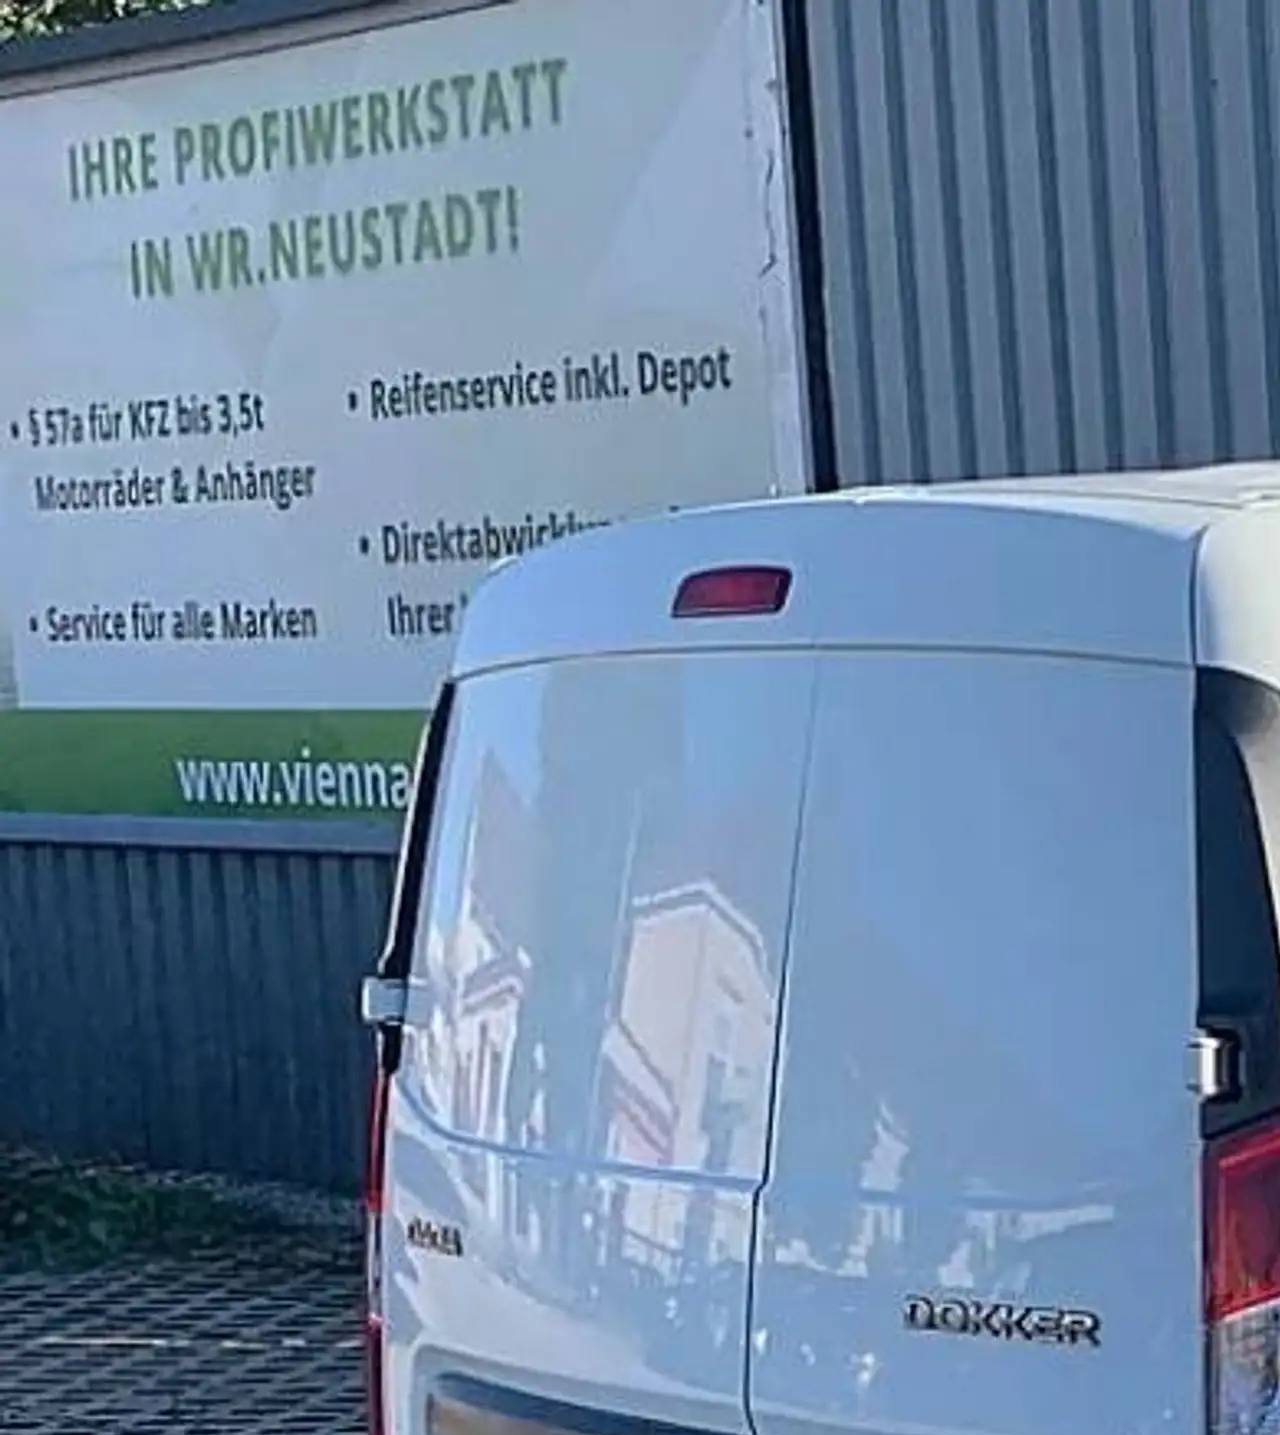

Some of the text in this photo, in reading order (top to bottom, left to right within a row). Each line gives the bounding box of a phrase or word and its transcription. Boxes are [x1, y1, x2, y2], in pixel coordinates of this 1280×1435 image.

[68, 57, 569, 203] IHRE PROFIWERKSTATT
[130, 184, 520, 300] IN WR.NEUSTADT!
[370, 345, 732, 420] Reifenservice inkl. Depot
[44, 407, 84, 445] 57a
[88, 402, 122, 442] für
[128, 400, 171, 440] KFZ
[176, 394, 212, 435] bis
[215, 392, 264, 438] 3,5t
[34, 459, 316, 512] Motorräder & Anhänger
[46, 598, 318, 643] Service für alle Marken
[387, 592, 454, 637] Ihrer
[176, 745, 411, 809] www.vienna
[902, 1294, 1102, 1348] DOKKER
